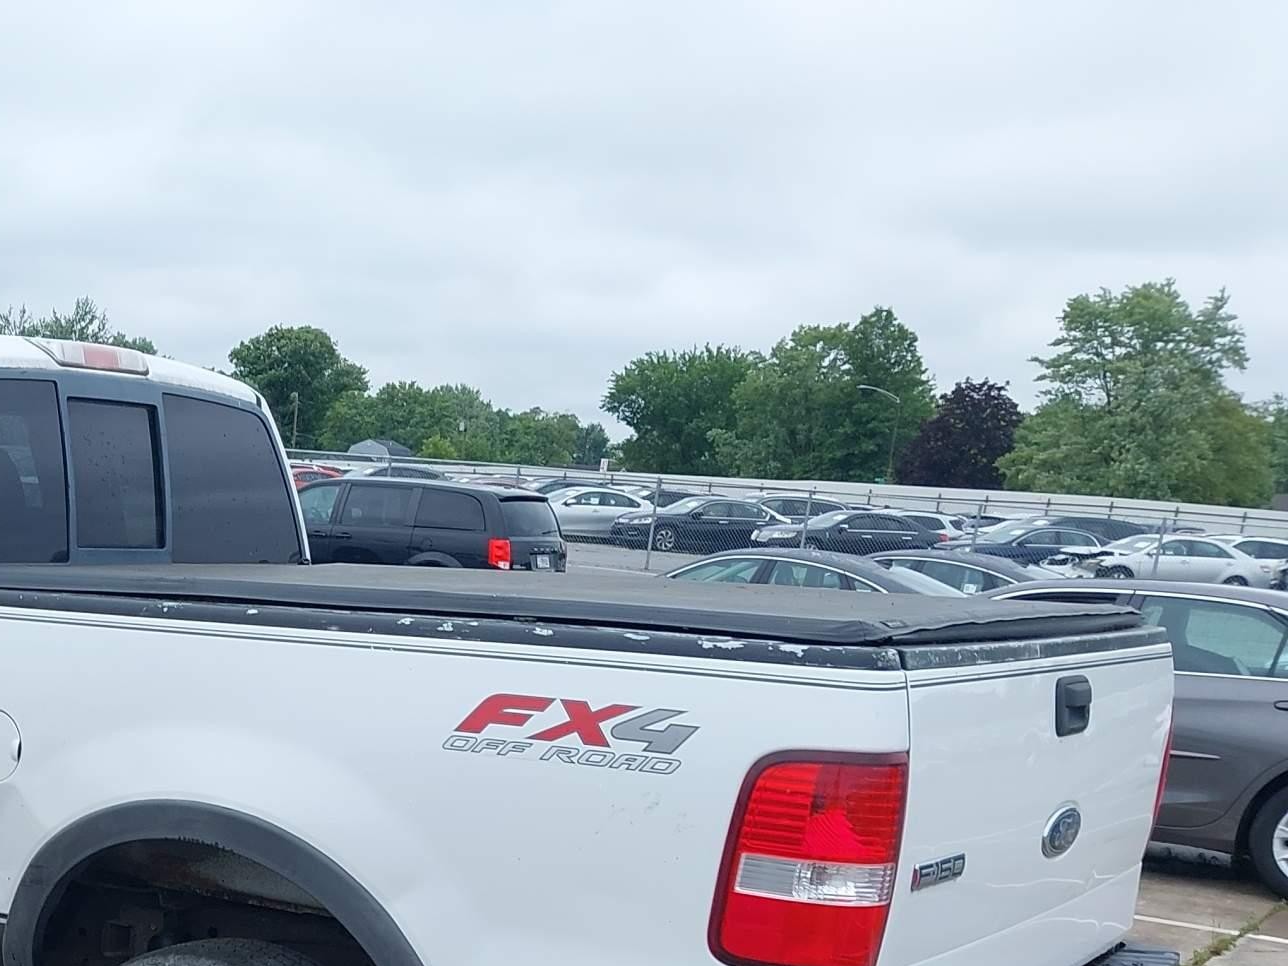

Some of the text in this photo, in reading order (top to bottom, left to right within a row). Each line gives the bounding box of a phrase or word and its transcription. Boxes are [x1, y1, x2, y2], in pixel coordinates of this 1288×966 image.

[453, 693, 701, 755] FX4
[441, 734, 682, 775] OFF ROAD
